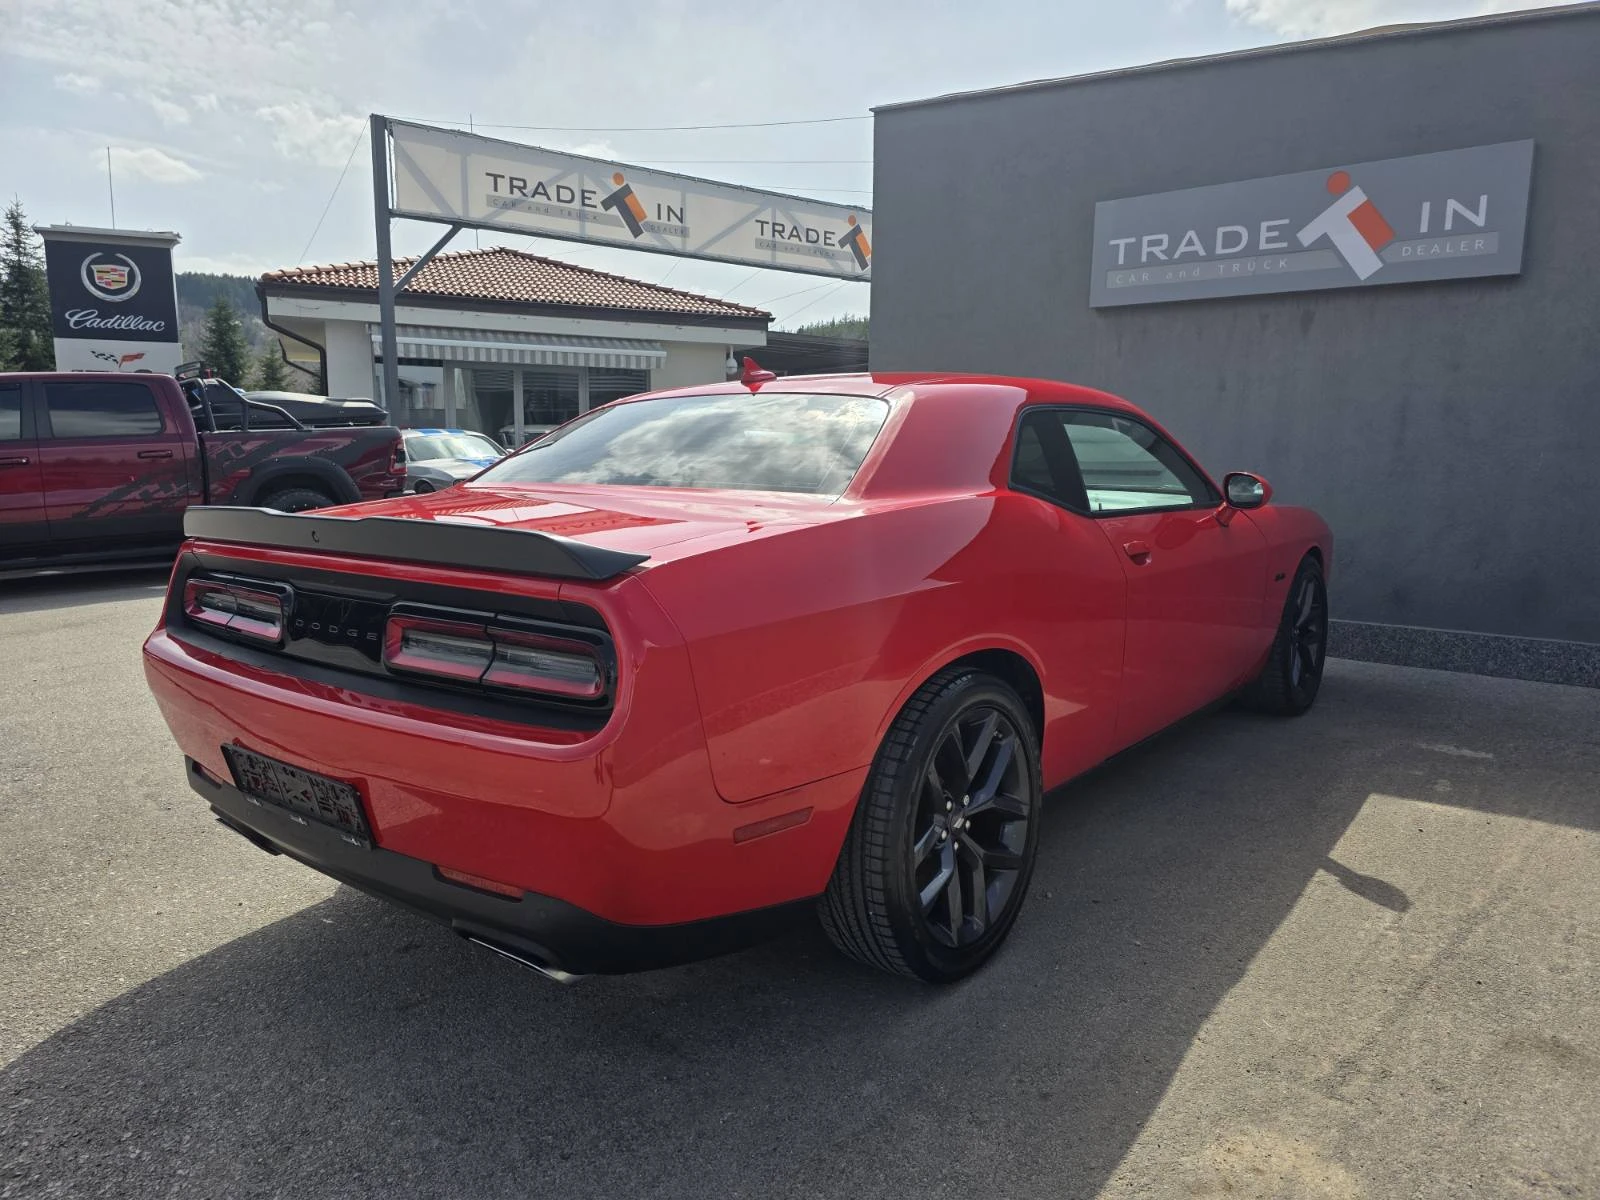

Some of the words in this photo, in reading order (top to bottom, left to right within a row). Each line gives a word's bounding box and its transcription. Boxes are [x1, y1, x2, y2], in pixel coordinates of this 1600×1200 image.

[485, 172, 598, 209] TRADE
[657, 203, 684, 224] IN
[755, 219, 836, 247] TRADE
[1109, 218, 1290, 264] TRADE
[1419, 194, 1488, 233] IN
[1115, 272, 1150, 284] CAR
[1165, 266, 1200, 280] and
[1217, 257, 1288, 274] TRUCK
[1401, 239, 1485, 257] DEALER
[65, 309, 165, 332] Cadillac
[295, 619, 378, 641] DODGE
